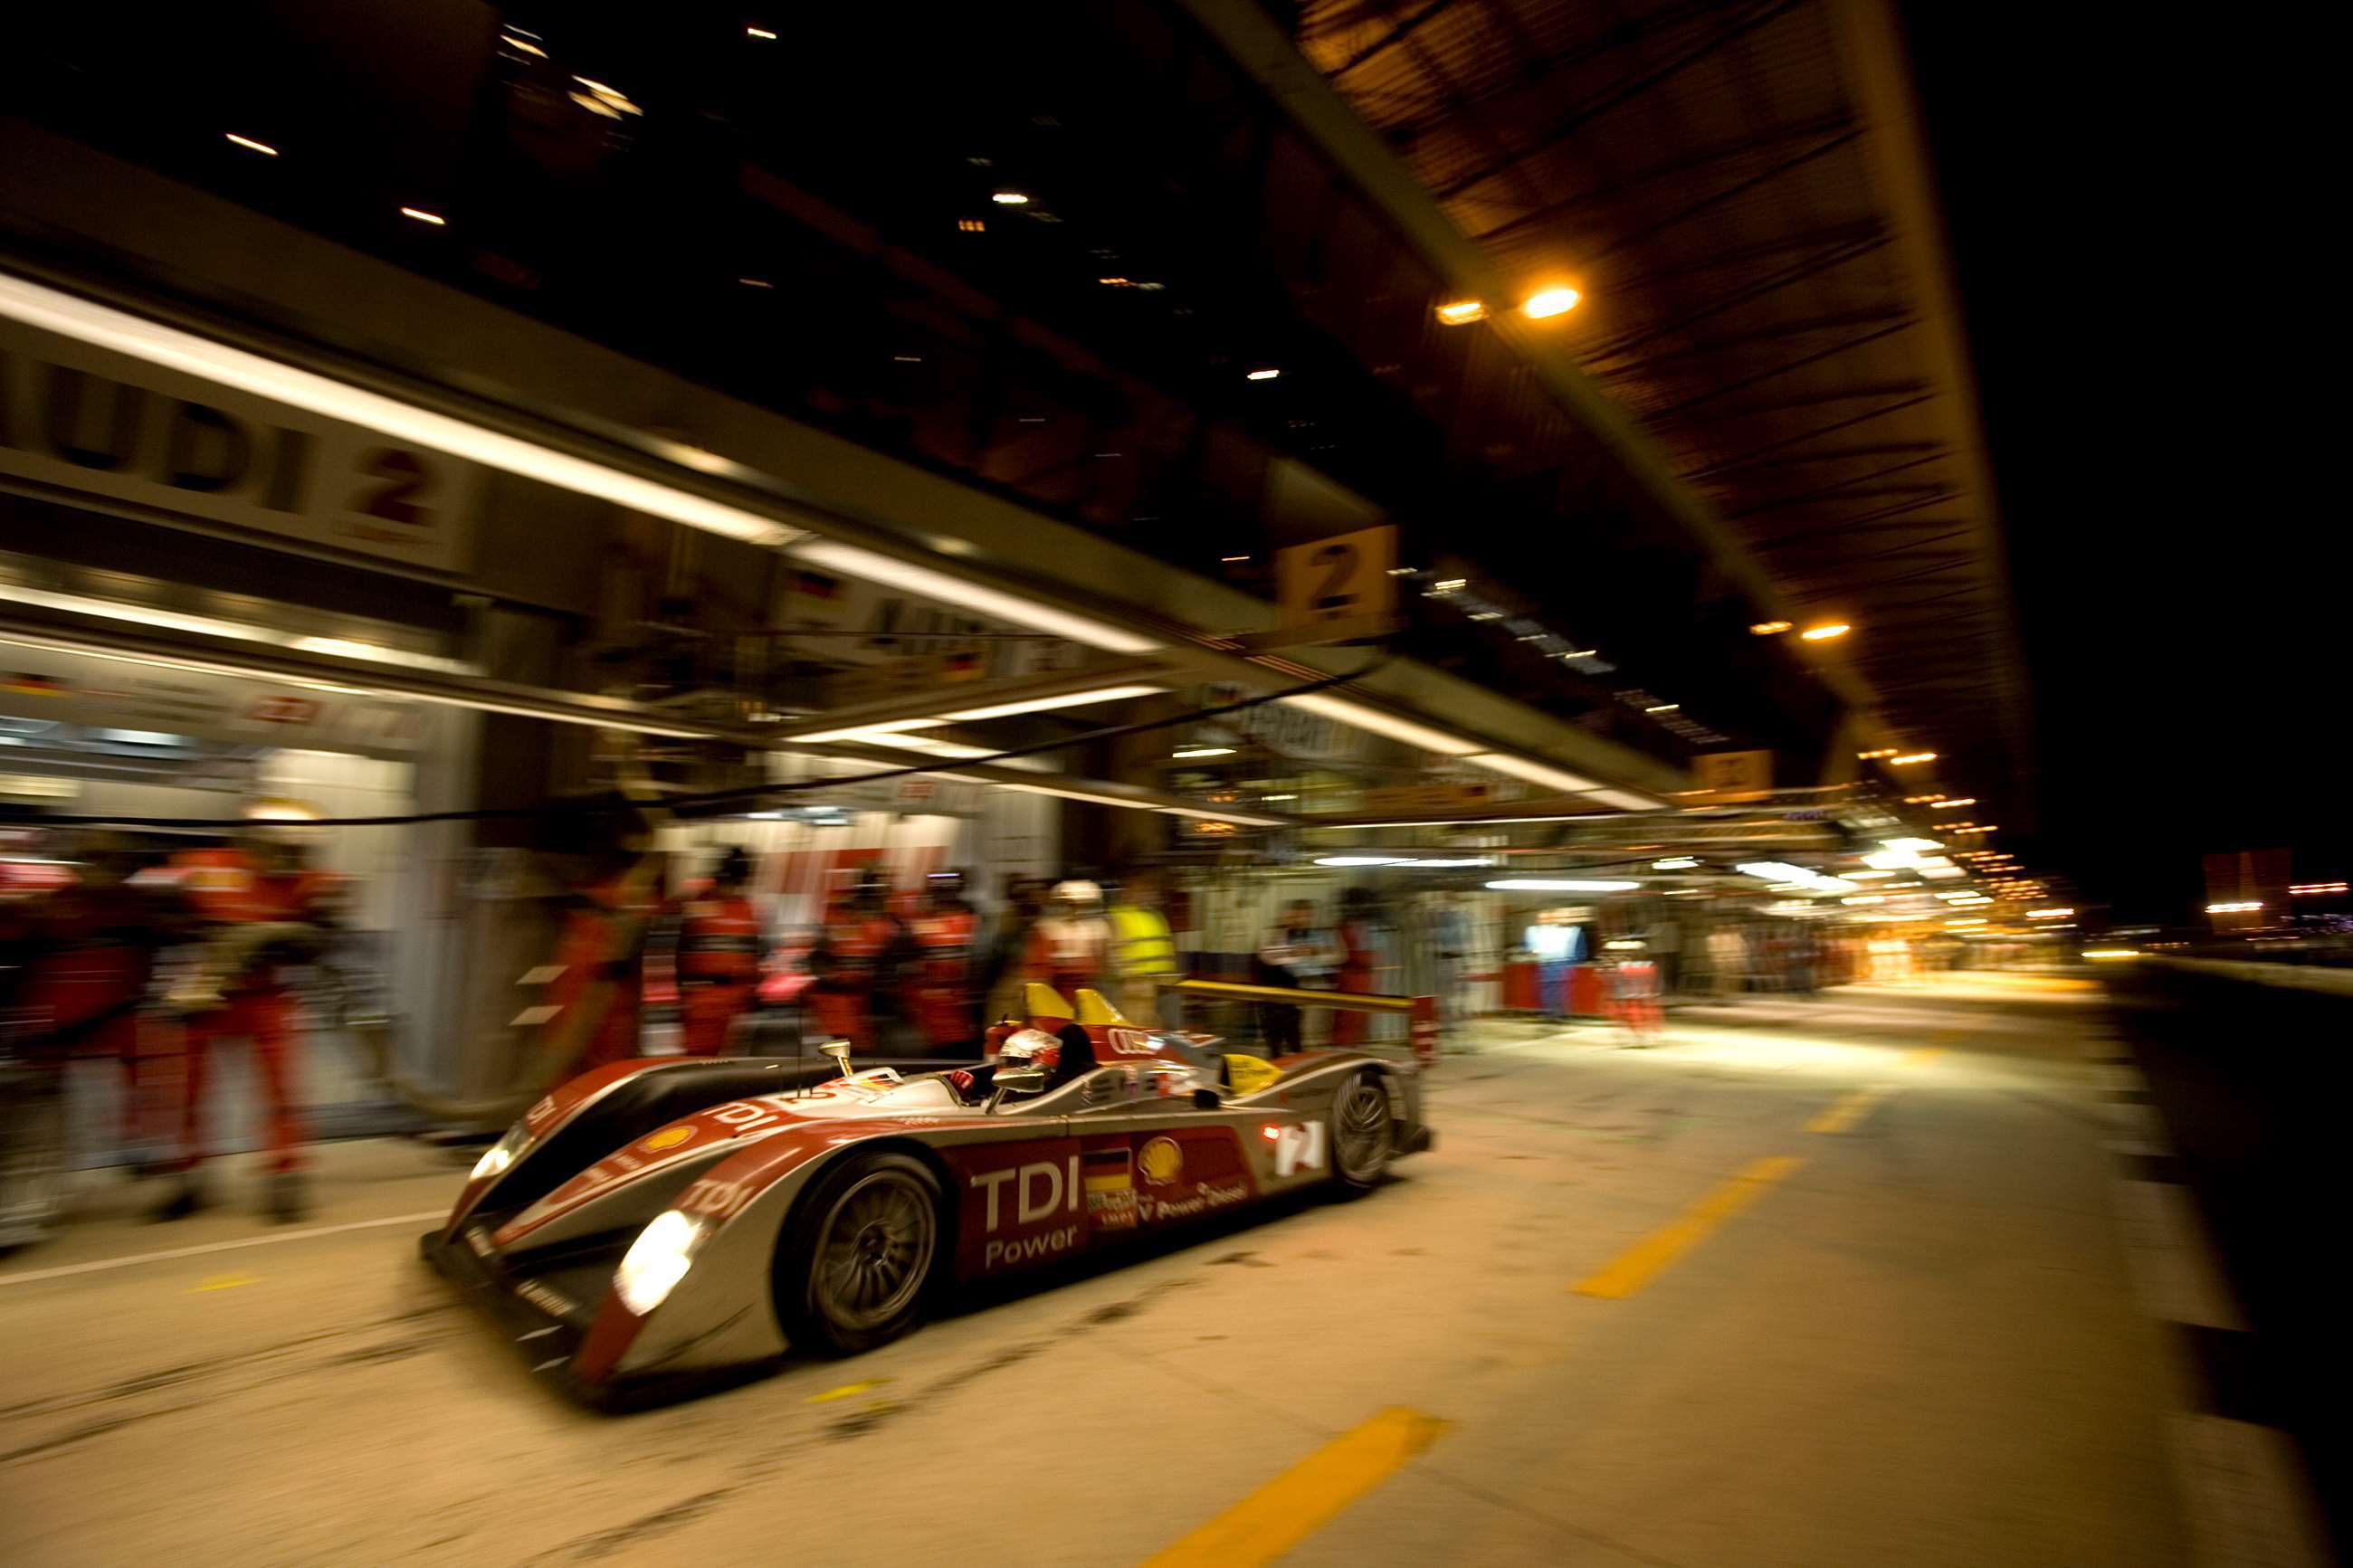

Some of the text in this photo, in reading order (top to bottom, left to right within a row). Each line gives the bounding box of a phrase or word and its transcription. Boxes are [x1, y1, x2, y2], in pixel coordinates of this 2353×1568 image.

[353, 447, 442, 527] 2
[1310, 544, 1361, 611] 2
[681, 1179, 758, 1217] TDI
[970, 1155, 1079, 1232] TDI
[986, 1225, 1077, 1269] Power
